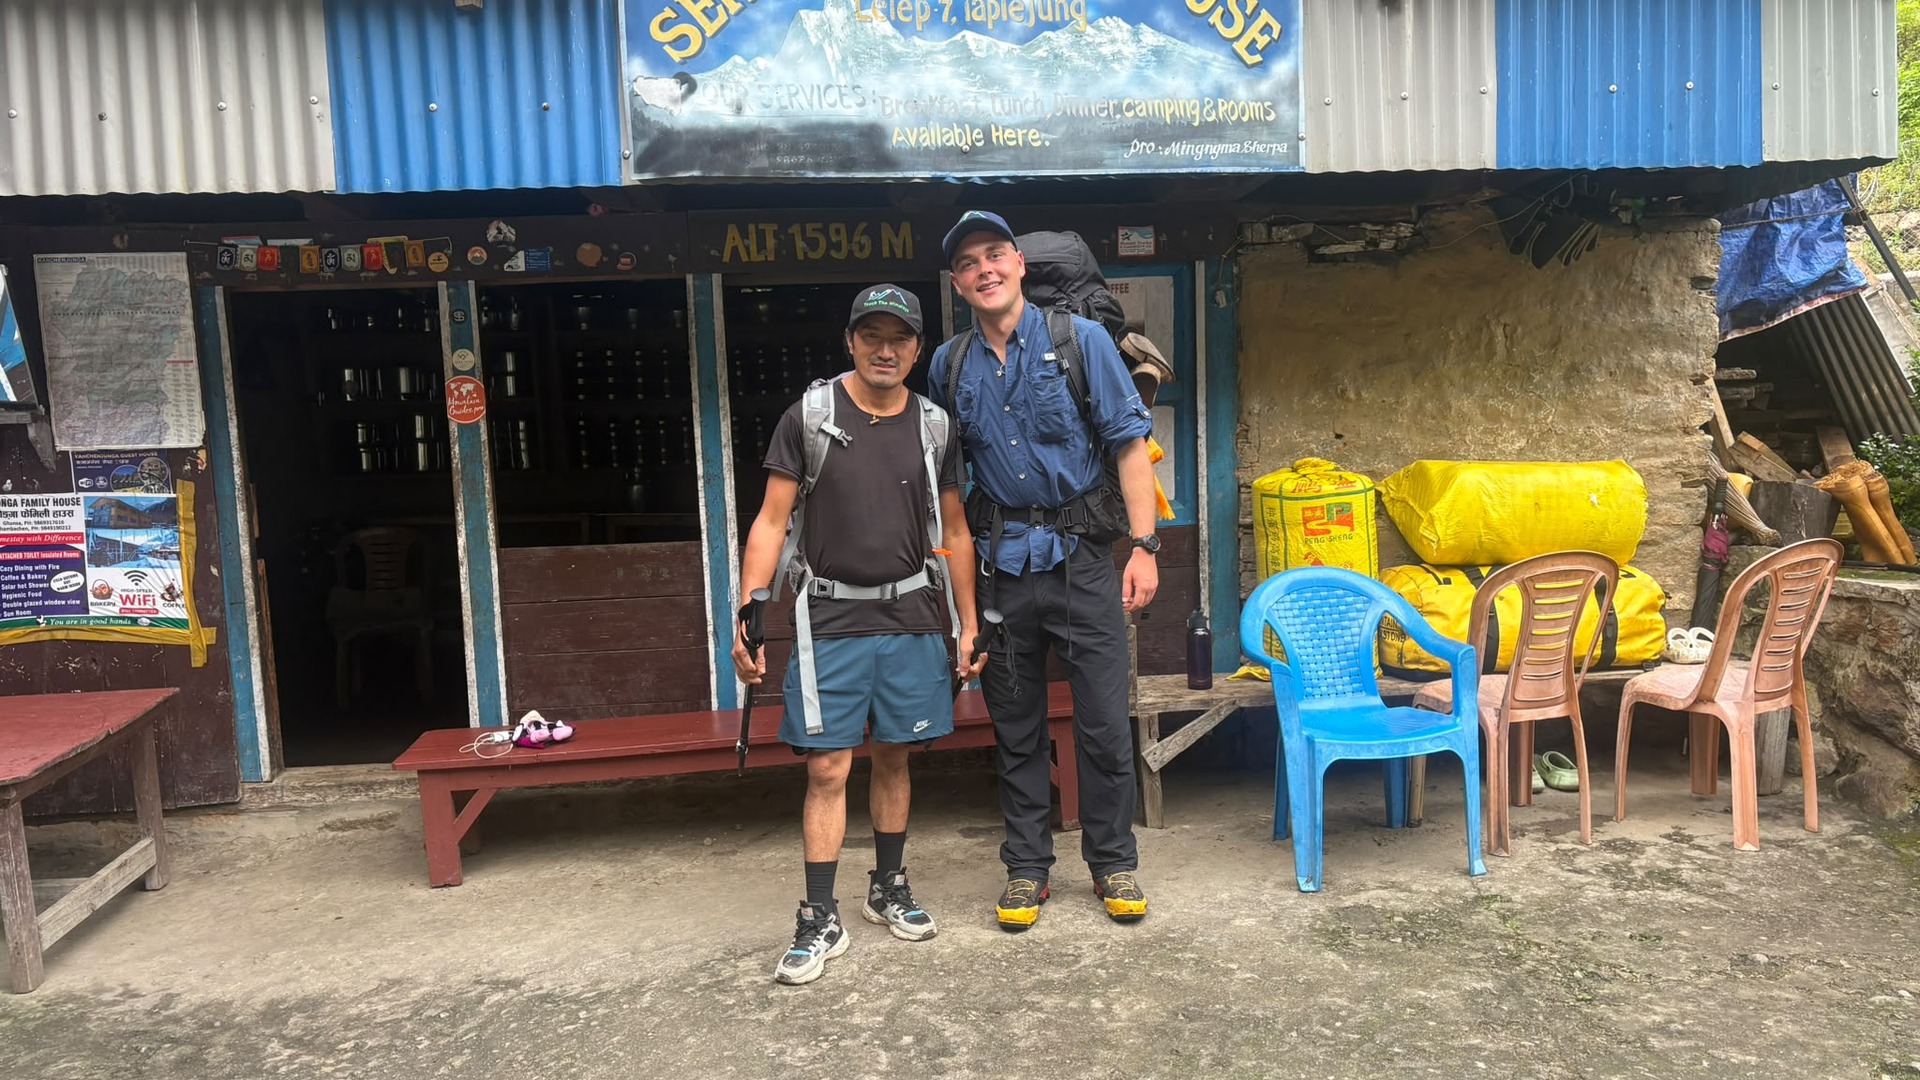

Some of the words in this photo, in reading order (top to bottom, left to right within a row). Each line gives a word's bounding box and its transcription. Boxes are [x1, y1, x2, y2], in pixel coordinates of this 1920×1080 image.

[649, 0, 745, 63] SE
[892, 121, 985, 148] Available
[991, 124, 1051, 148] Here.
[722, 223, 778, 263] ALT
[788, 221, 871, 261] 1596
[880, 221, 914, 260] M
[0, 498, 18, 508] NGA
[21, 498, 50, 507] FAMILY
[53, 497, 81, 506] HOUSE
[44, 534, 82, 542] Difference
[1328, 533, 1353, 542] SHENG
[14, 564, 33, 572] Dining
[1, 592, 27, 600] Hygienic
[119, 593, 157, 606] WiFi
[50, 618, 63, 626] You
[80, 617, 88, 625] in
[89, 617, 107, 627] good
